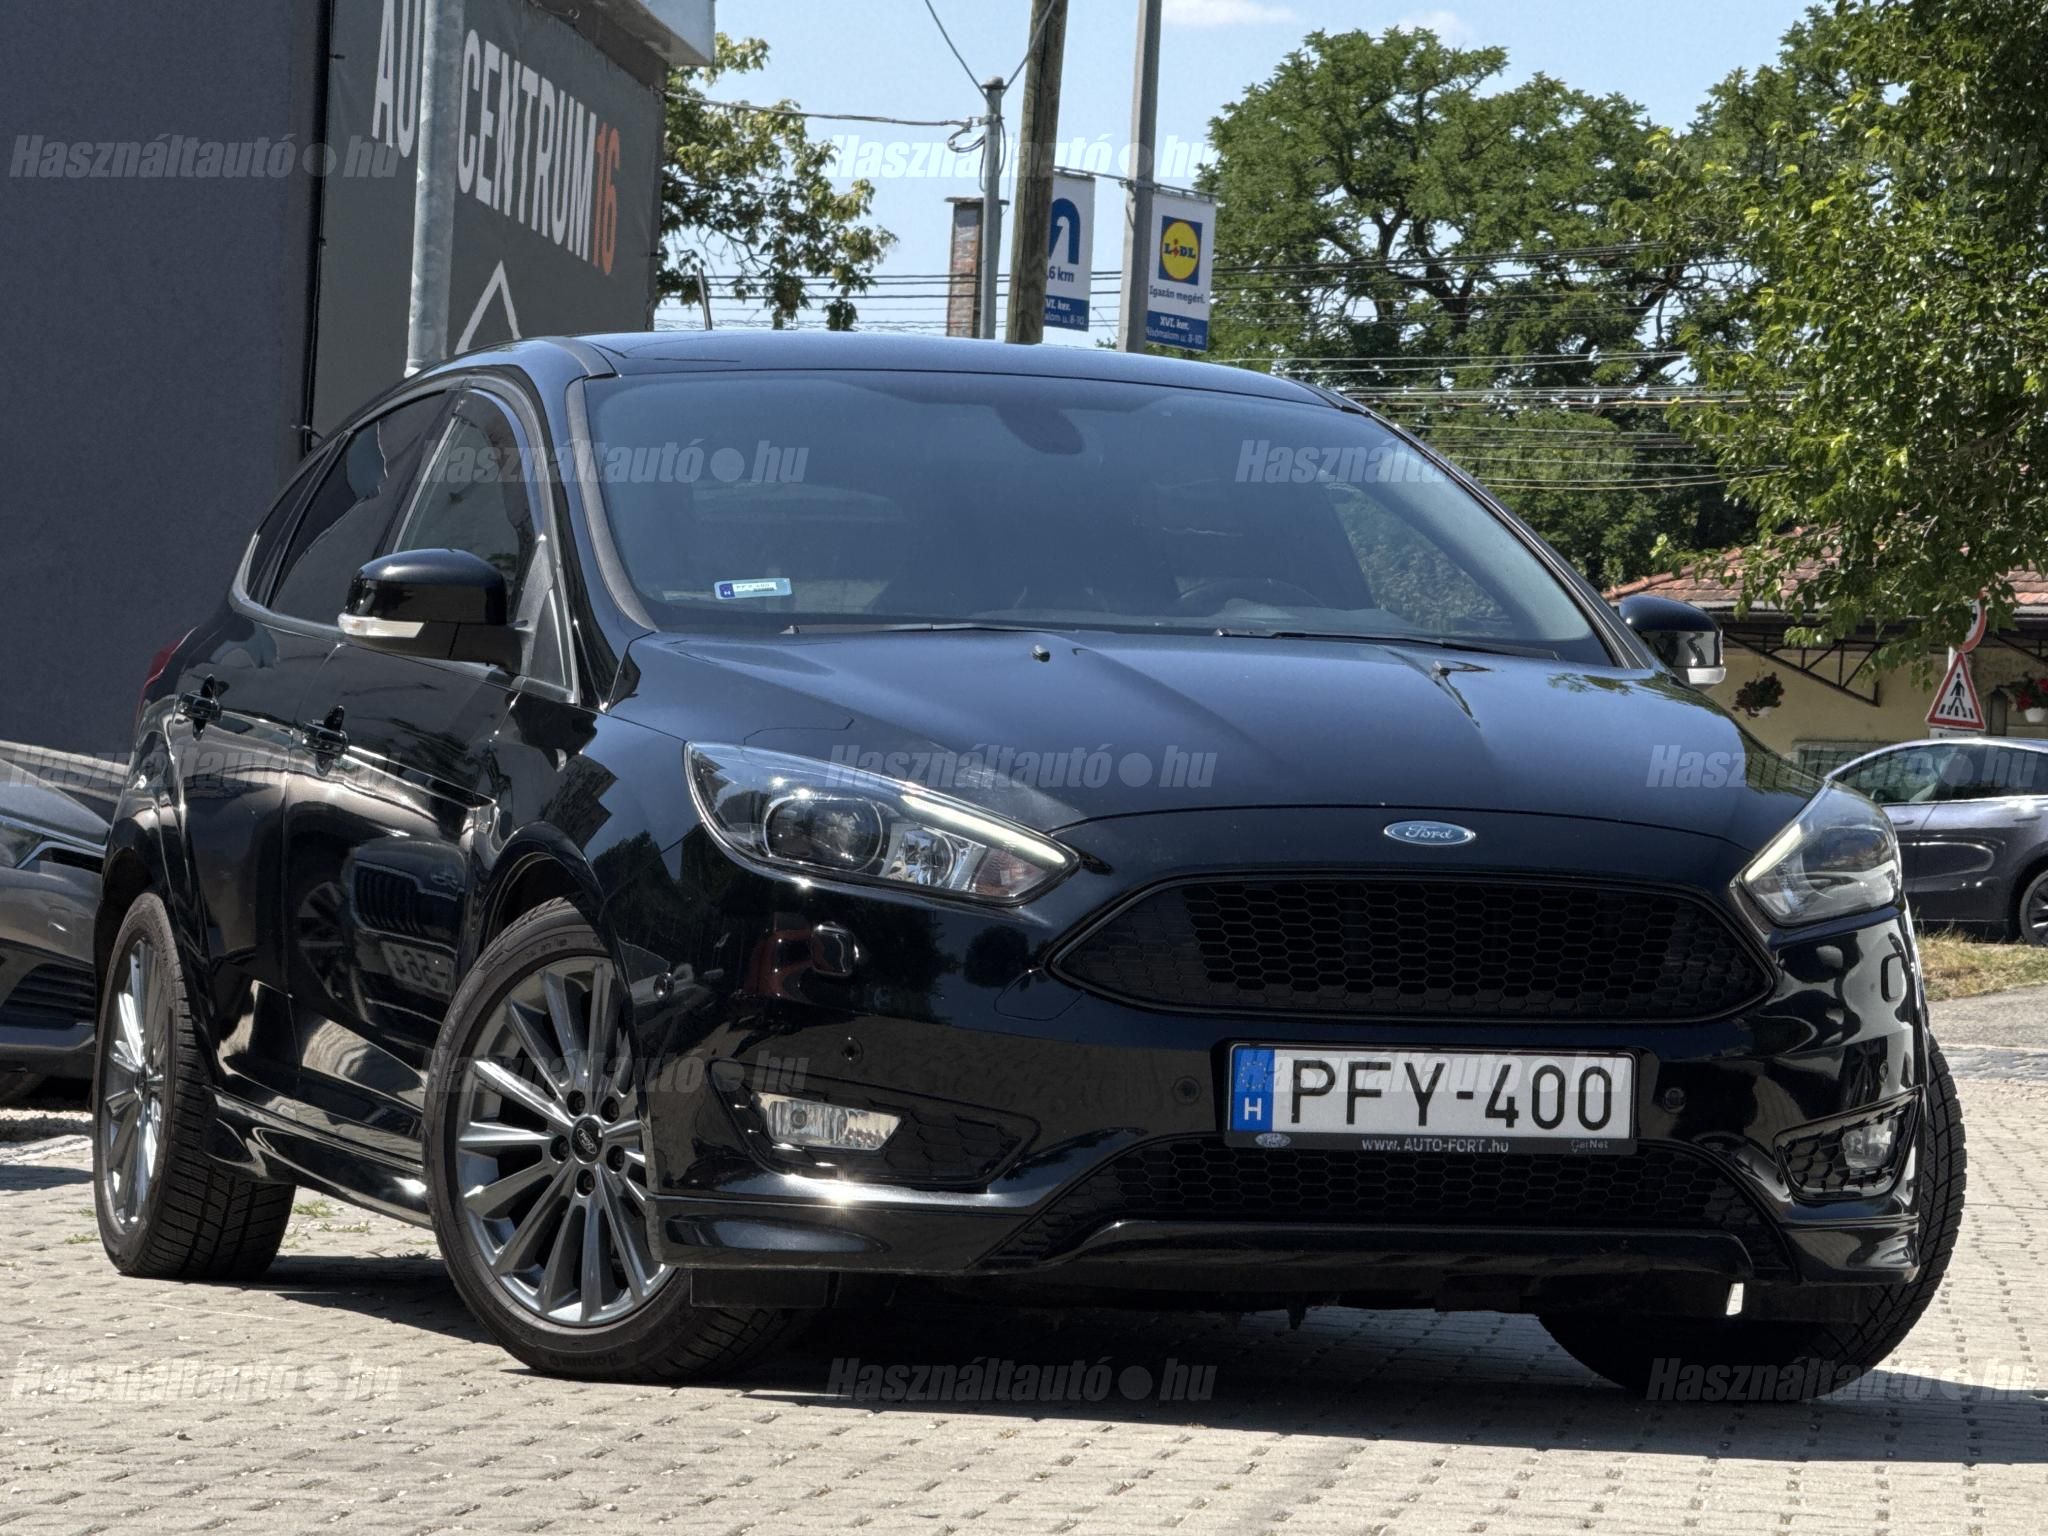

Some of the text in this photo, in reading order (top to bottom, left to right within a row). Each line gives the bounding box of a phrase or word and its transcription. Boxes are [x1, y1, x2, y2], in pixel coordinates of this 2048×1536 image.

[1057, 266, 1075, 283] km
[1244, 1059, 1612, 1130] H PFY-400
